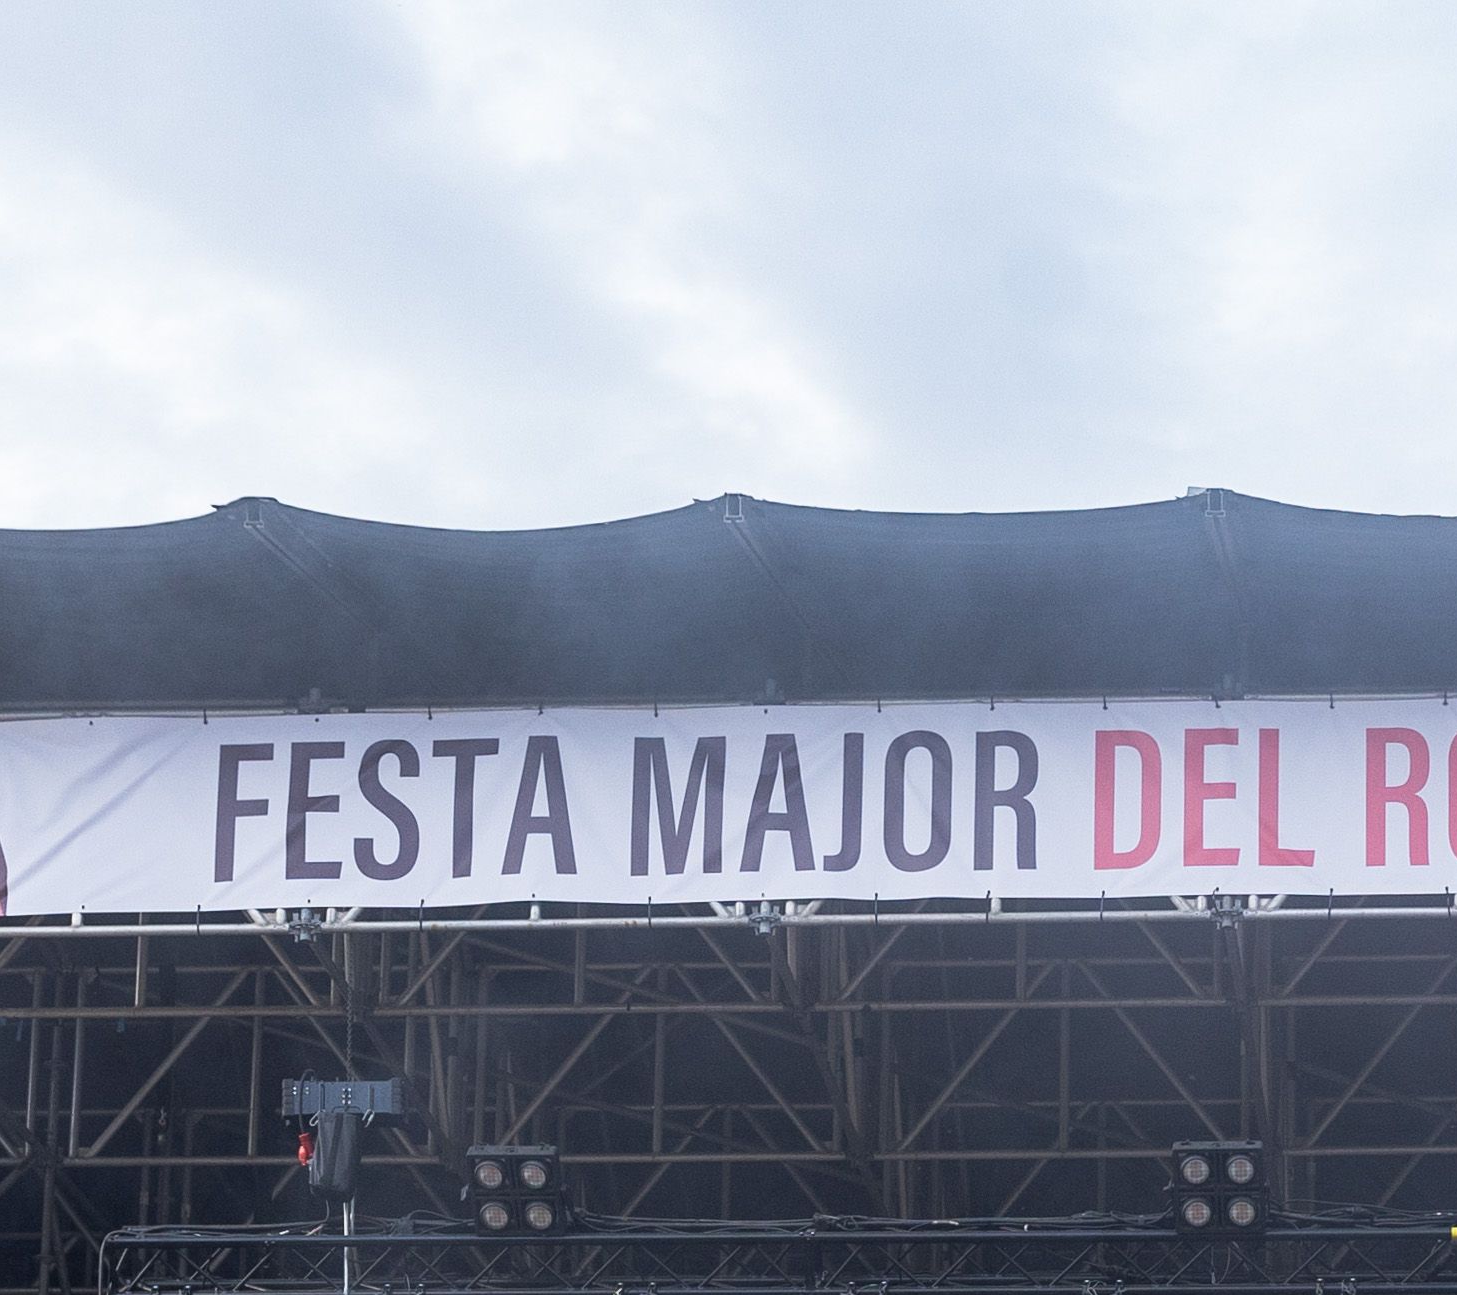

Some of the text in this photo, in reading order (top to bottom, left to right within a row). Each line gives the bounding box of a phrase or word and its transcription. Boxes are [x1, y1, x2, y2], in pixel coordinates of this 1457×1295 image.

[214, 735, 578, 883] FESTA
[630, 729, 1039, 876] MAJOR
[1093, 728, 1316, 870] DEL
